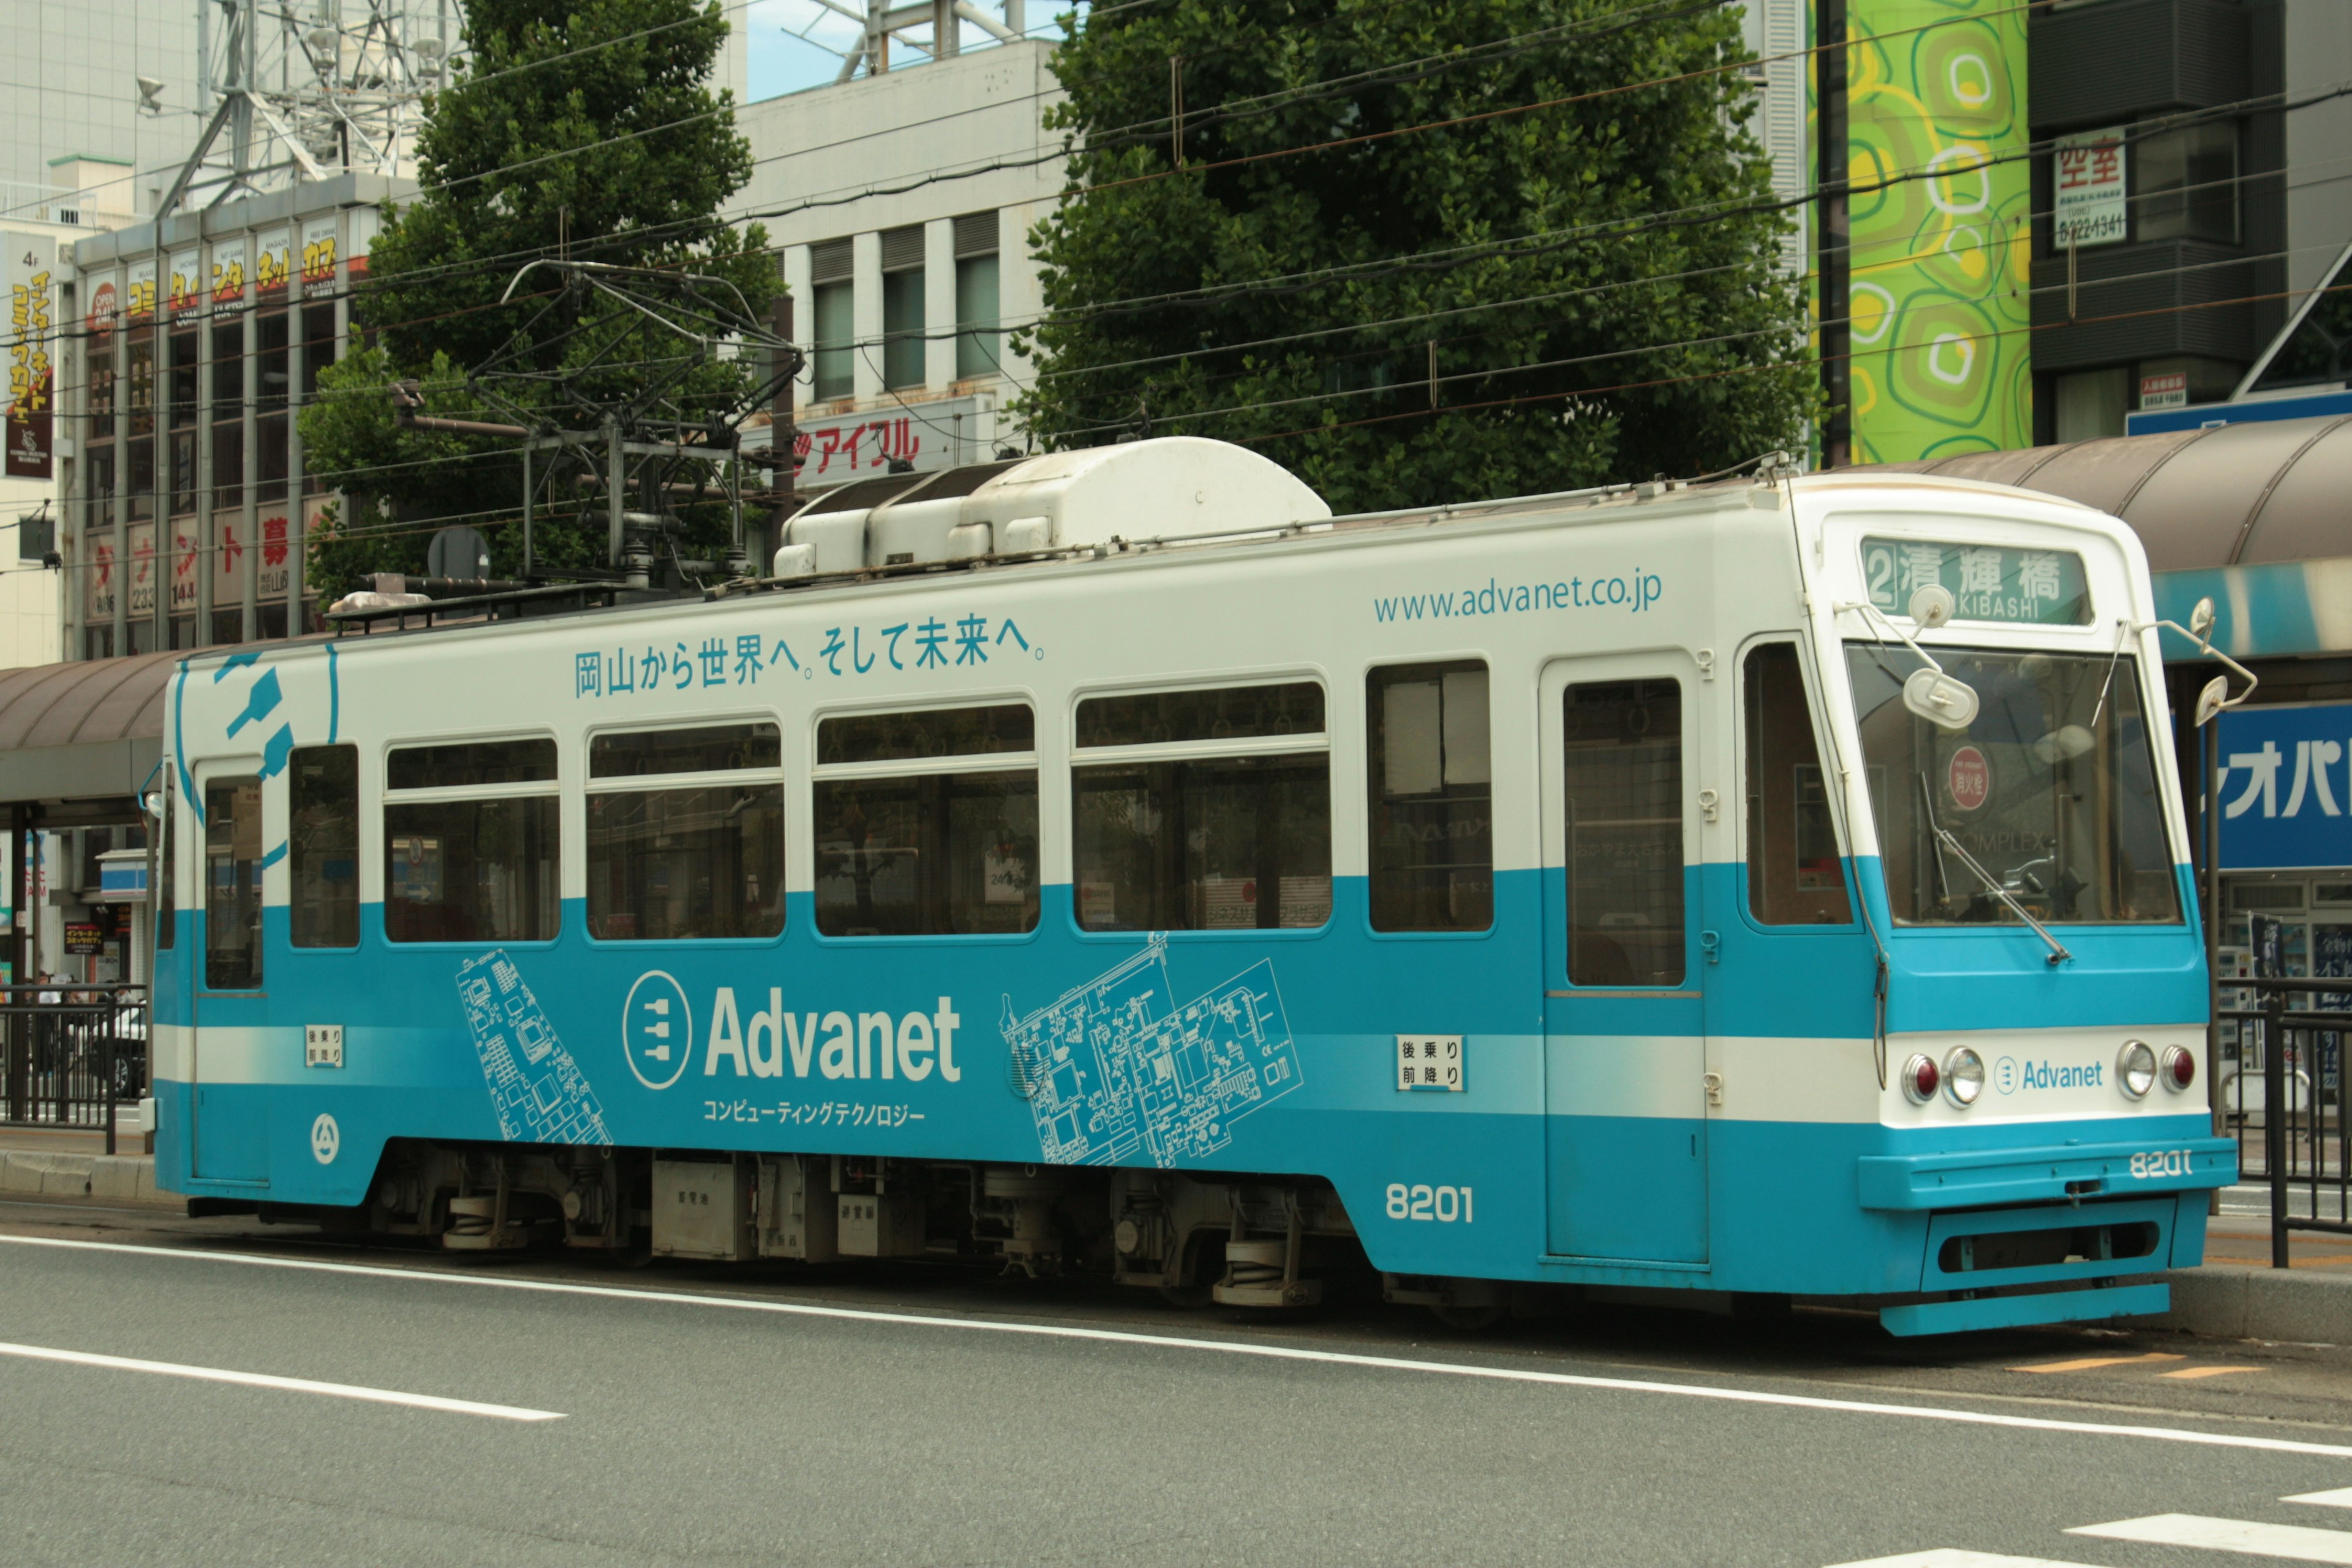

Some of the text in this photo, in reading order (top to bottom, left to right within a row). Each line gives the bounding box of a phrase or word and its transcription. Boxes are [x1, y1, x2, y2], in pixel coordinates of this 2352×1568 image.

[2060, 135, 2120, 189] 空室
[23, 251, 39, 266] 4F
[96, 292, 115, 306] OPEN
[10, 284, 29, 424] コミックカフェ
[31, 270, 50, 411] インターネット
[804, 415, 919, 474] アイフル
[1868, 548, 1893, 603] 2
[1900, 543, 2060, 601] 清輝橋
[172, 582, 197, 605] 144
[1374, 567, 1662, 623] www.advanet.co.jp
[1951, 593, 2038, 619] IKIBASHI
[575, 612, 1045, 699] 岡山から世界へ。そして未来へ。
[1955, 771, 1983, 795] 消火栓
[2200, 737, 2352, 820] オパ
[704, 987, 961, 1082] Advanet
[1403, 1041, 1458, 1059] 後乗り
[1403, 1066, 1458, 1084] 前降り
[2022, 1060, 2103, 1089] Advanet
[704, 1099, 925, 1127] コンピューティングテクノロジー
[2130, 1149, 2193, 1179] 8201
[1386, 1183, 1472, 1223] 8201
